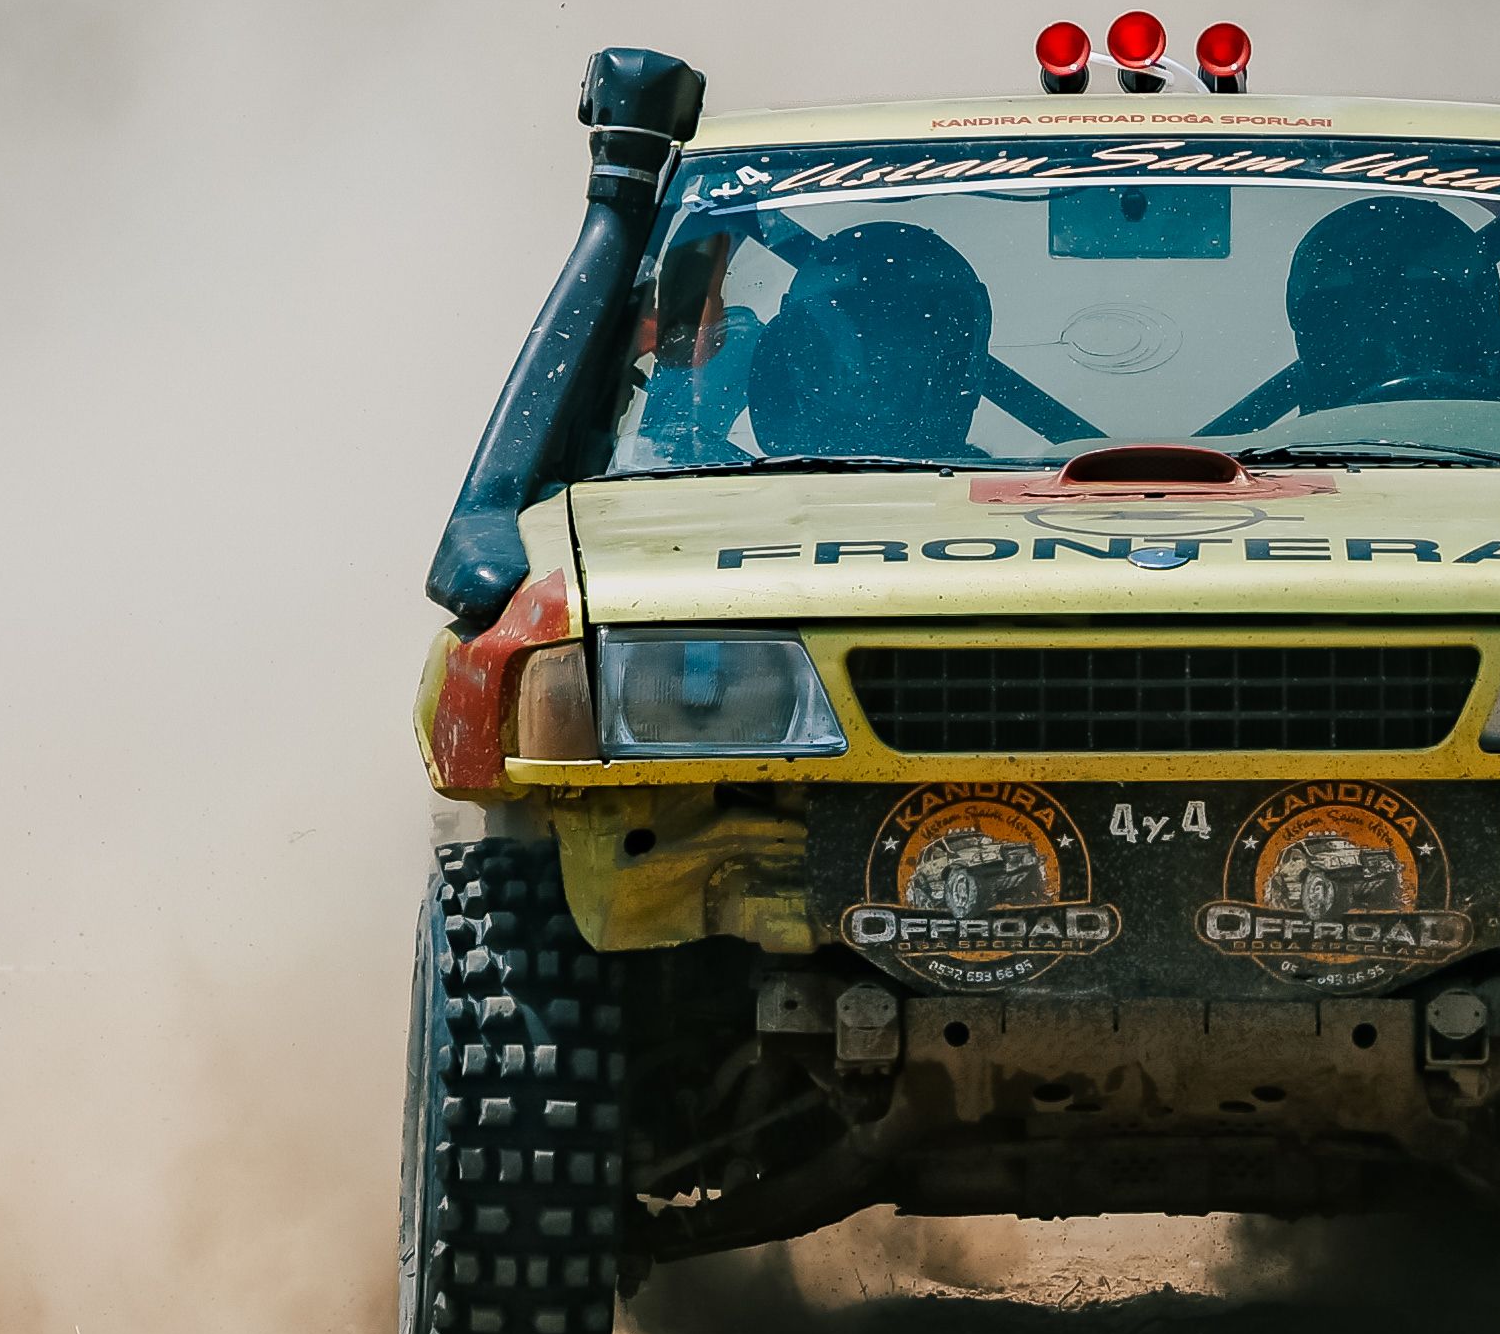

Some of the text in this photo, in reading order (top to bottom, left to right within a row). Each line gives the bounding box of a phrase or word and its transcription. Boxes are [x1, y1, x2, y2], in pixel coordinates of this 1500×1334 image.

[1037, 114, 1146, 125] OFFROAD
[1219, 115, 1333, 128] SPORLARI
[896, 782, 1057, 831] KANDIRA
[1257, 782, 1418, 838] KANDIRA
[851, 907, 1110, 944] OFFROAD
